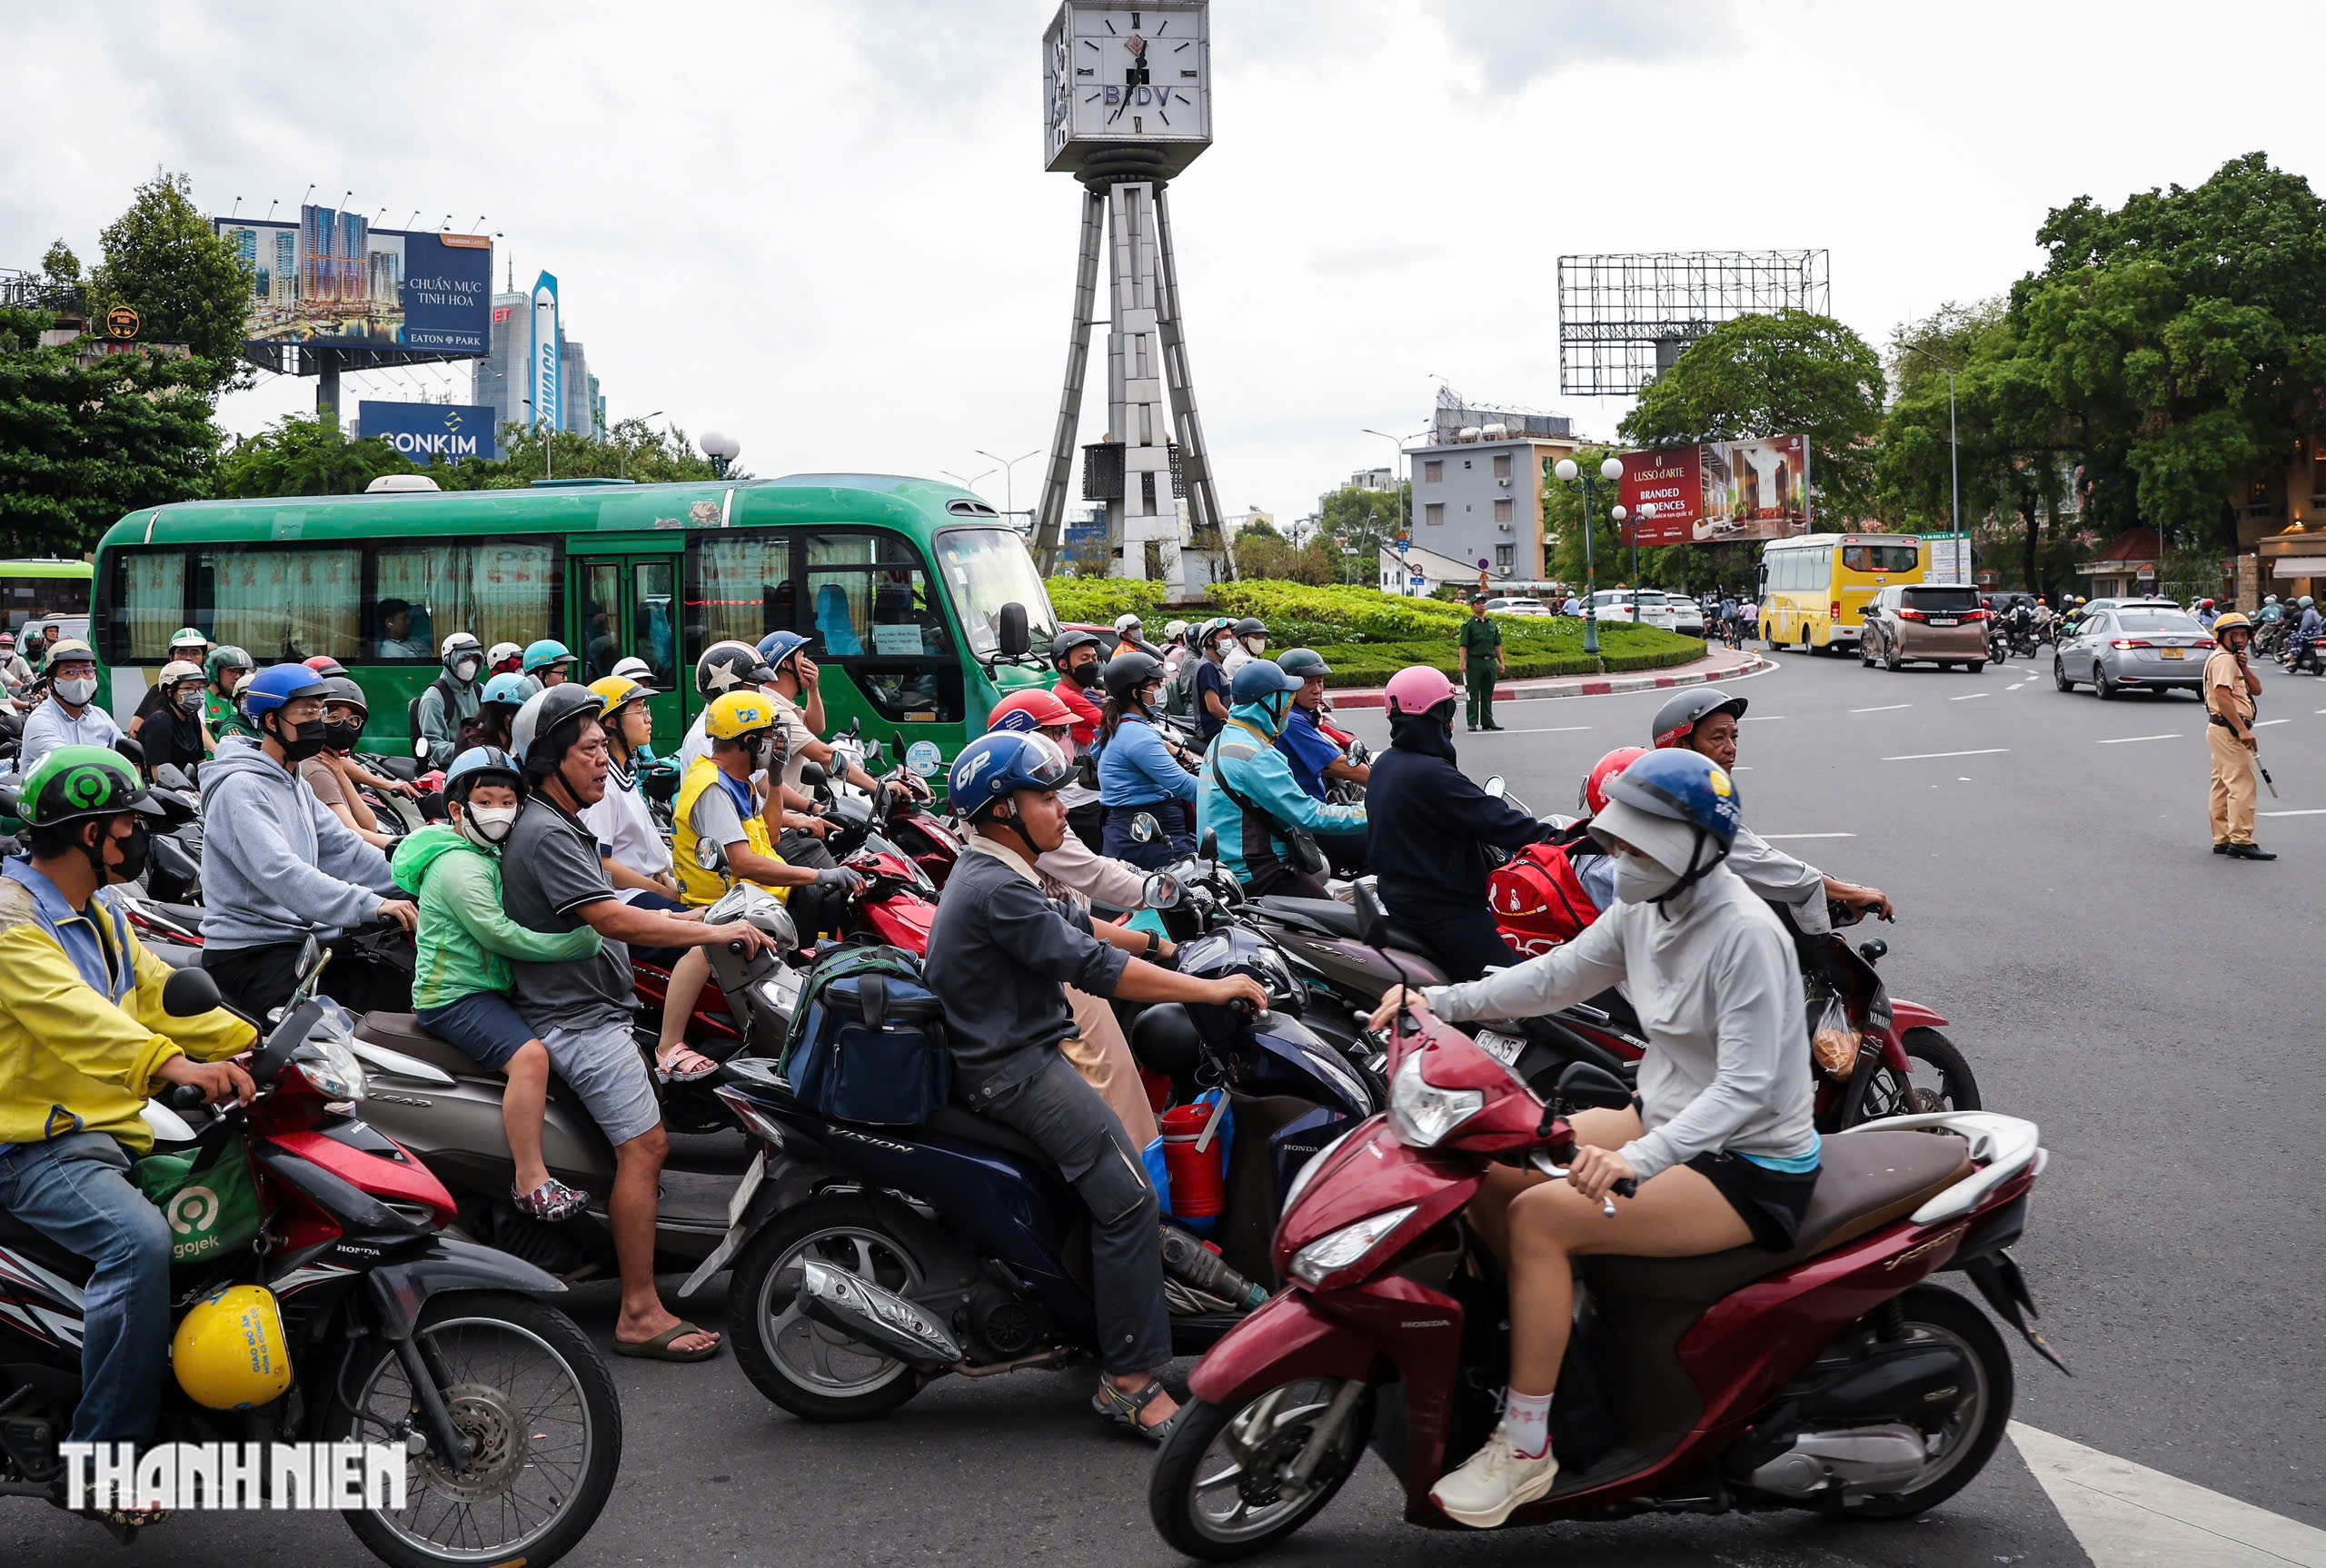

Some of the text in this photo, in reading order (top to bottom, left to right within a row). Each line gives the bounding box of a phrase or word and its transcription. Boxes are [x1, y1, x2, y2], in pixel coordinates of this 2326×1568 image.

[1104, 86, 1171, 107] BDV
[409, 276, 482, 294] CHUẨN MỰC
[417, 293, 474, 307] TINH HOA
[410, 333, 481, 346] EATON PARK
[1634, 470, 1659, 482] LUSSO
[1640, 487, 1680, 501] BRANDED
[734, 708, 760, 724] be
[956, 749, 990, 791] GP
[367, 1092, 432, 1107] LEAD
[826, 1124, 915, 1154] VISION
[1283, 1144, 1319, 1153] HONDA
[173, 1236, 220, 1259] gojek
[336, 1244, 381, 1255] HONDA
[1400, 1320, 1451, 1328] HONDA
